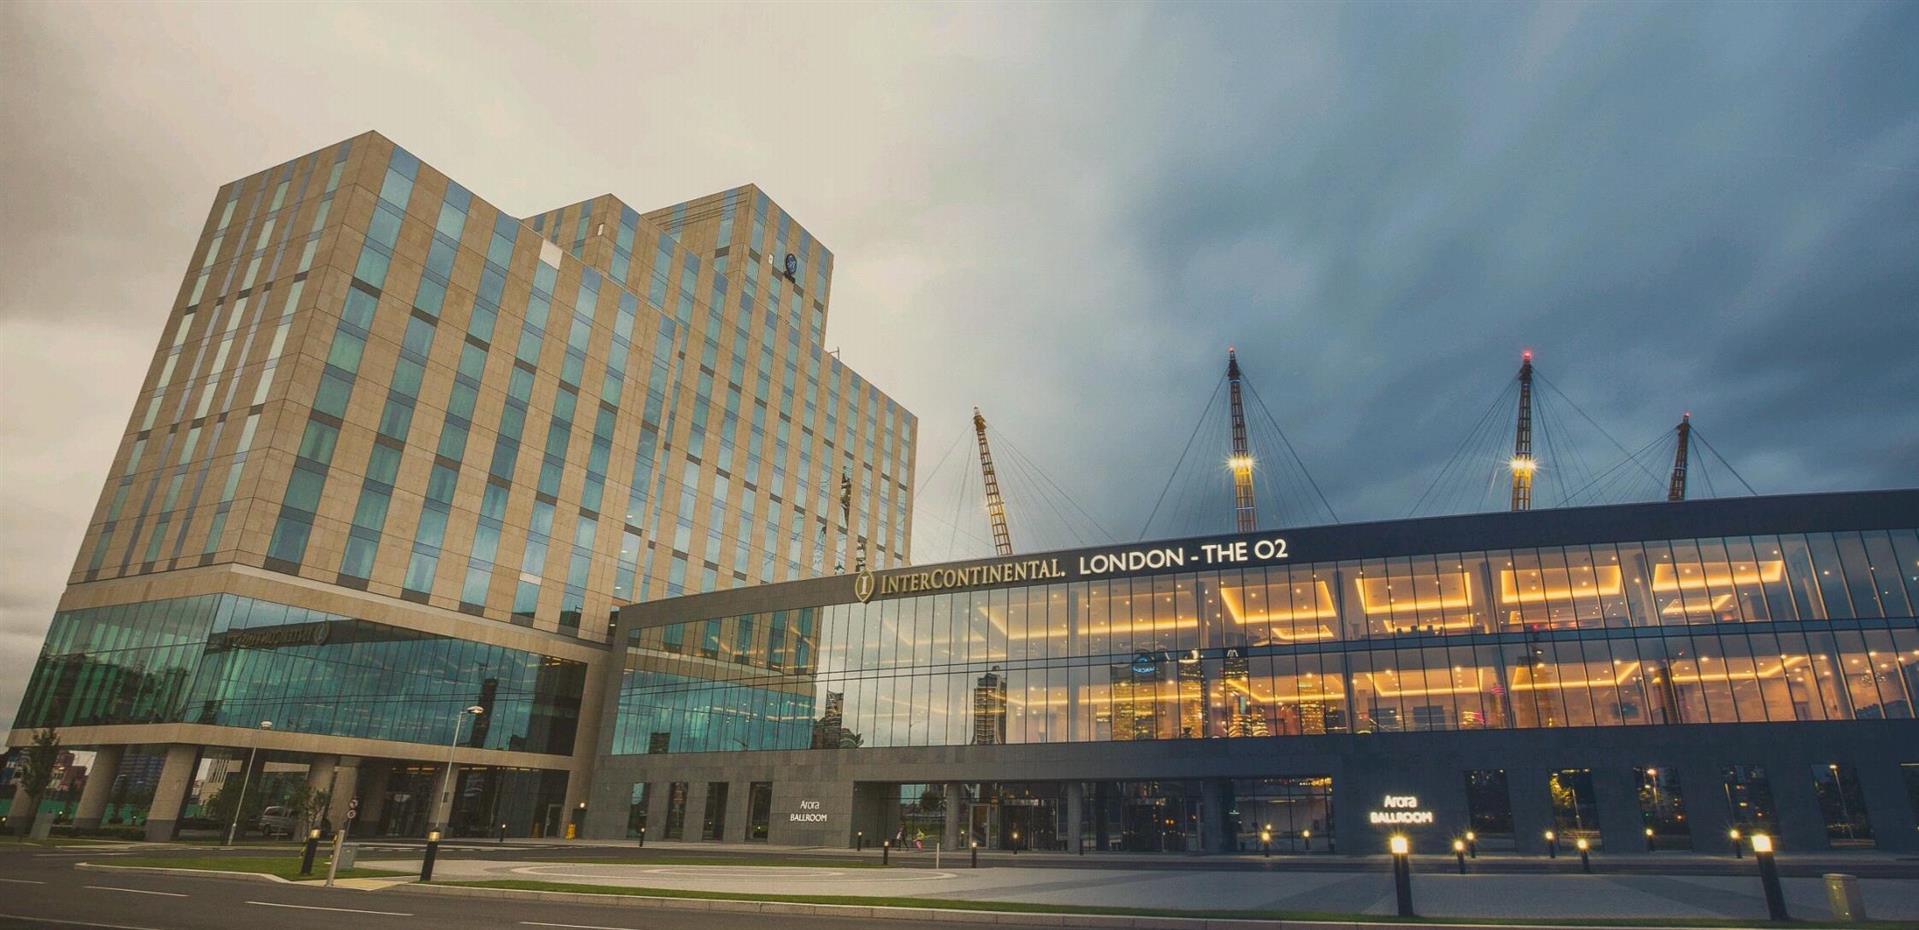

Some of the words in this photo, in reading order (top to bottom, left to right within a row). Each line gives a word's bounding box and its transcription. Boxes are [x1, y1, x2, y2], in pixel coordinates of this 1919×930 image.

[1080, 548, 1184, 575] LONDON
[1254, 538, 1288, 560] O2
[800, 800, 820, 810] Arora
[1384, 795, 1417, 808] Arora
[790, 813, 828, 822] BALLROOM
[1370, 811, 1433, 823] BALLROOM
